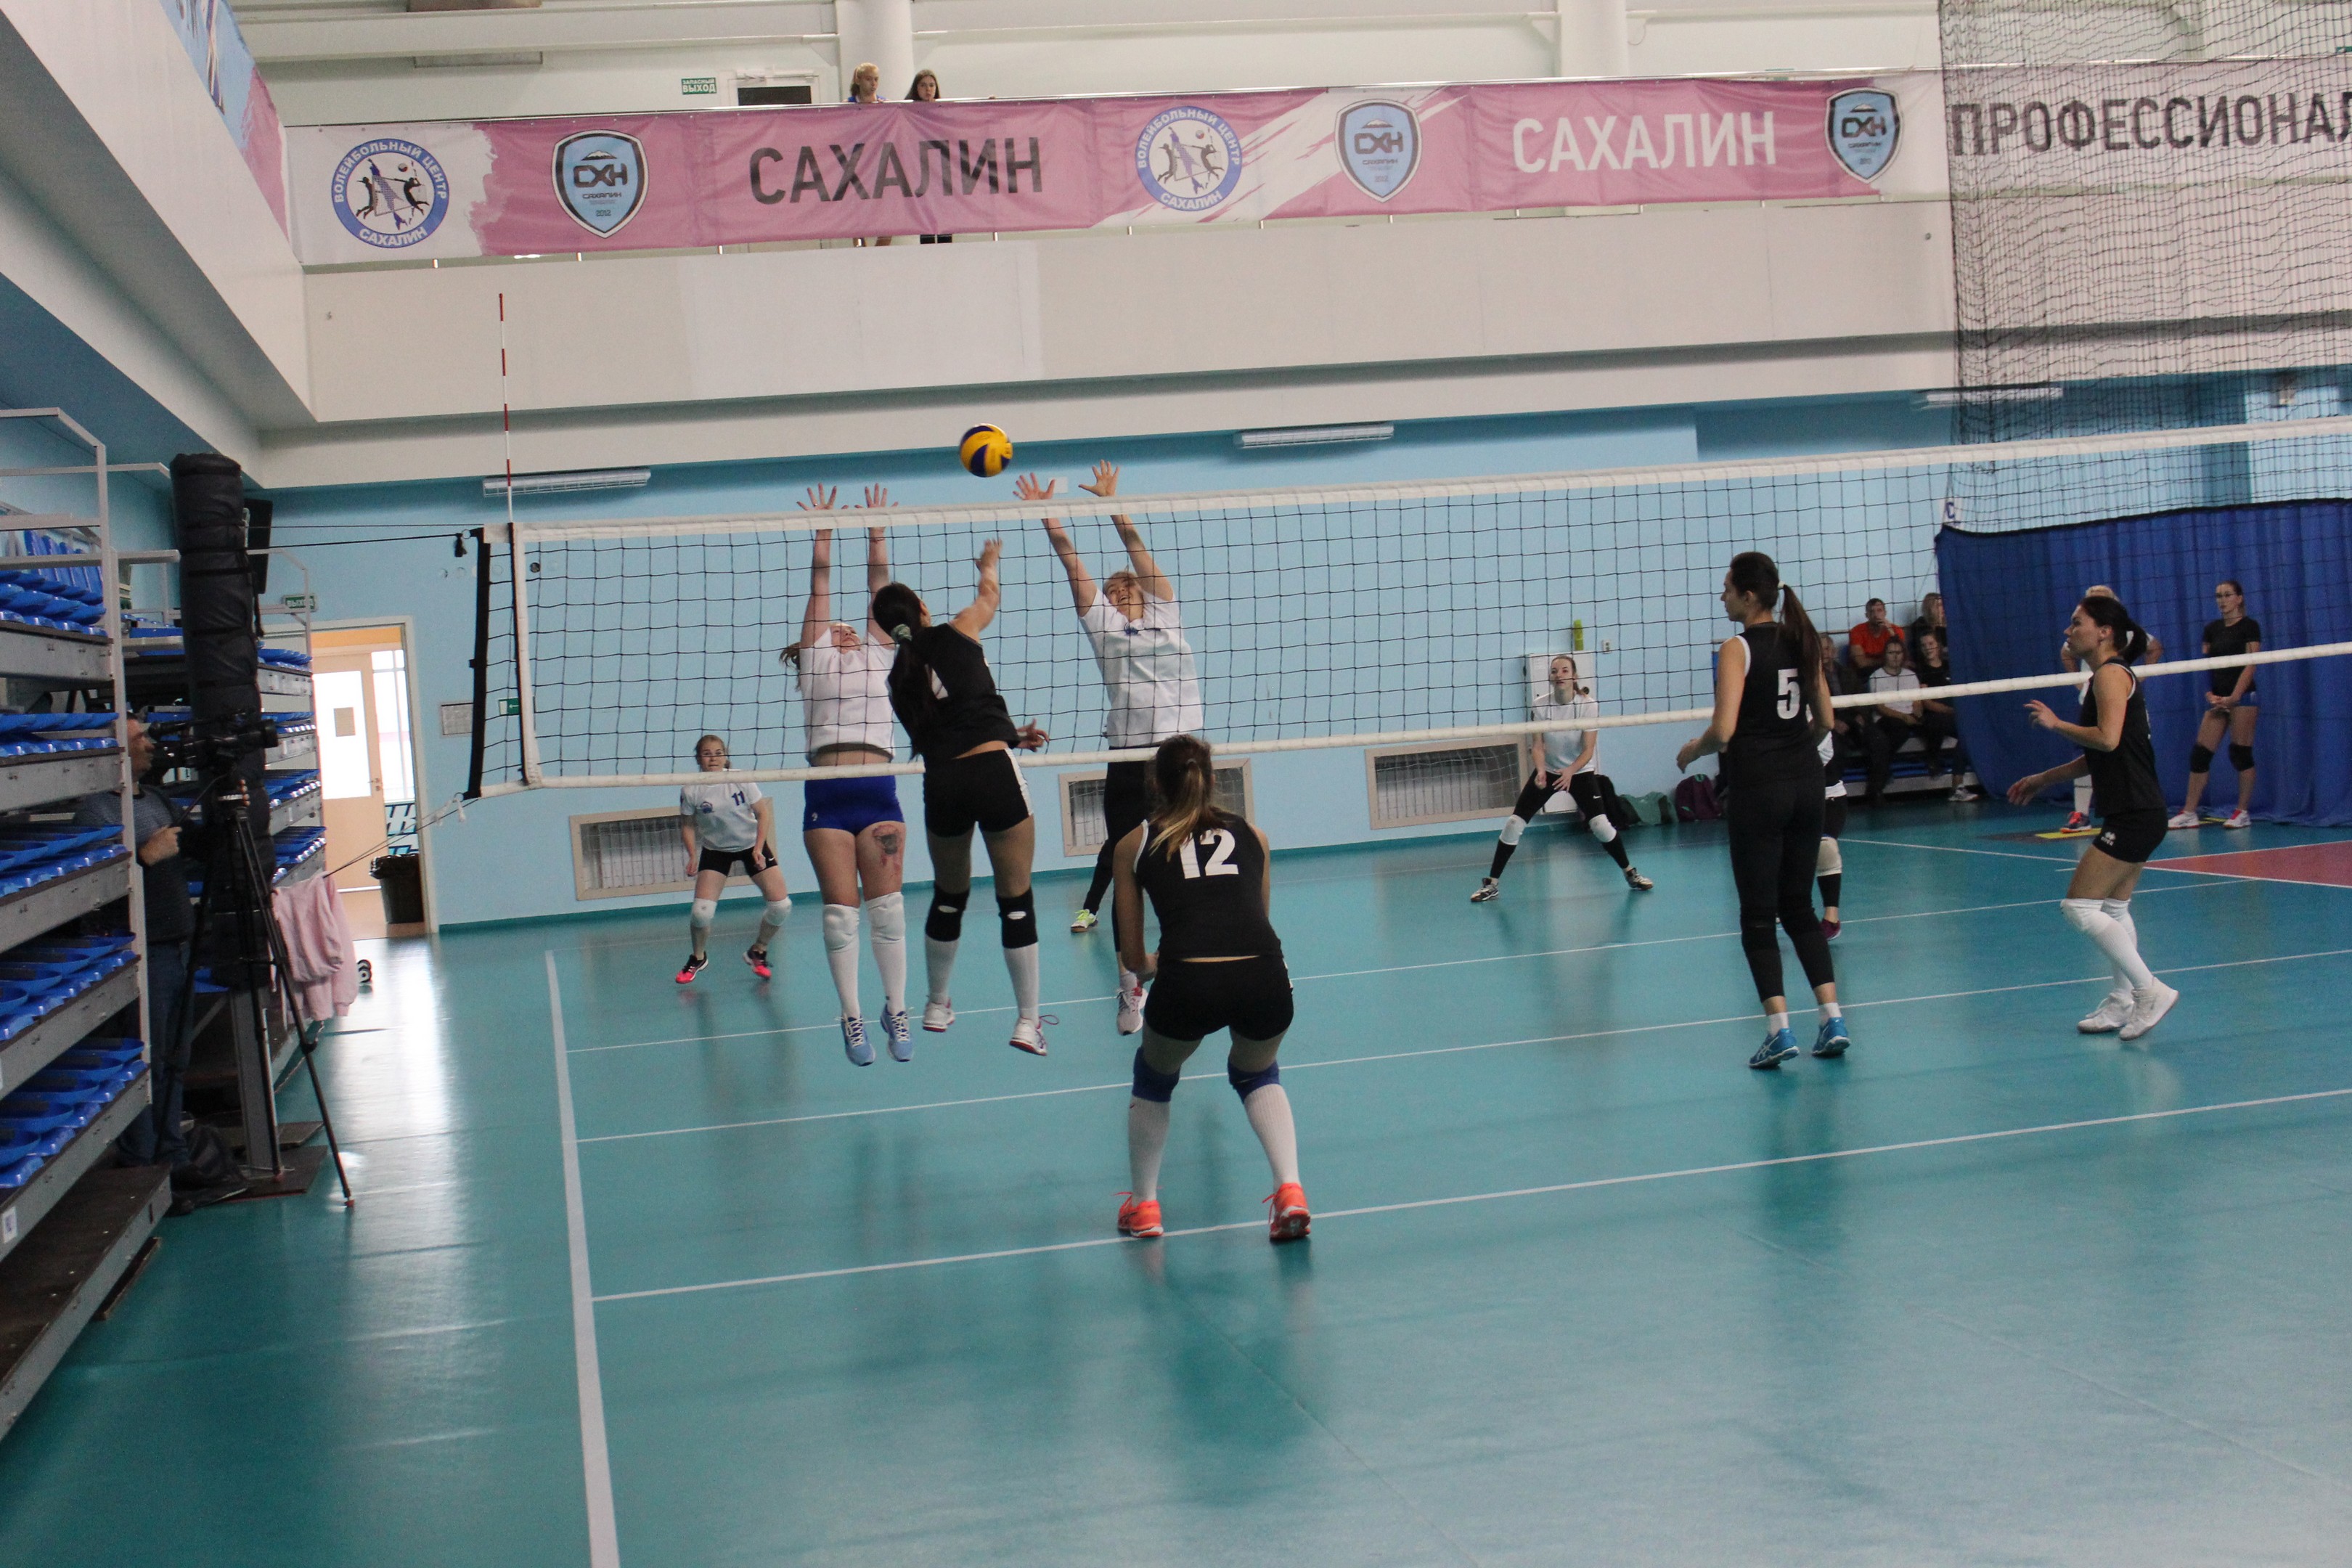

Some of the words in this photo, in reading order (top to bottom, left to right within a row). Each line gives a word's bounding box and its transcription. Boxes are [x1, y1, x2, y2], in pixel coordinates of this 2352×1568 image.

[682, 83, 716, 94] ВЫХОД
[1138, 109, 1218, 168] ВОЛЕЙБОЛЬНЫЙ
[1217, 123, 1240, 166] ЦЕНТР
[1513, 111, 1776, 173] САХАЛИН
[334, 142, 422, 203] ВОЛЕЙБОЛЬНЫЙ
[422, 155, 447, 199] ЦЕНТР
[749, 136, 1042, 205] САХАЛИН
[1160, 190, 1223, 209] САХАЛИН
[359, 226, 428, 245] САХАЛИН
[1776, 668, 1800, 719] 5
[731, 791, 746, 806] 11
[1179, 828, 1239, 879] 12
